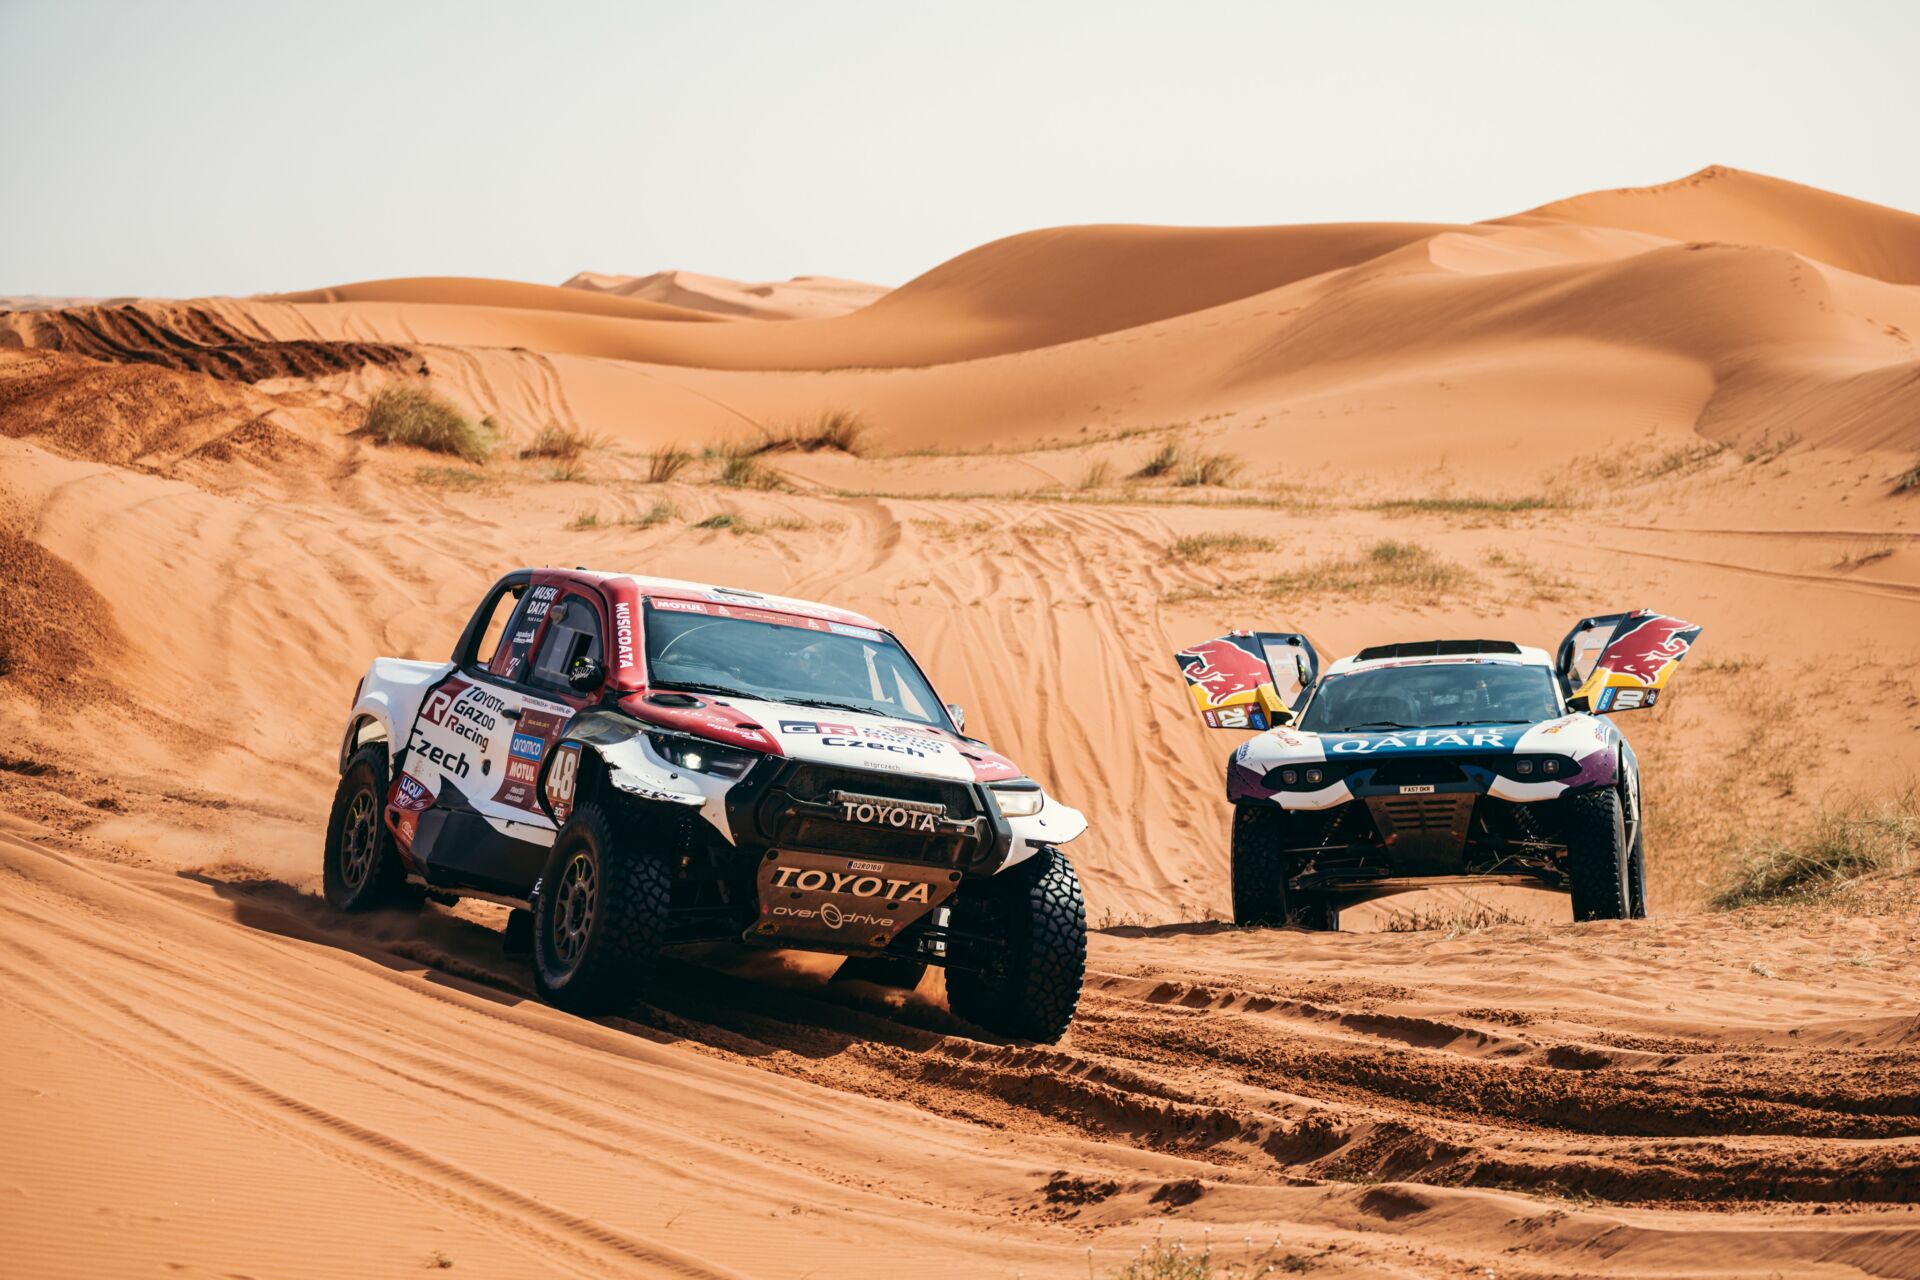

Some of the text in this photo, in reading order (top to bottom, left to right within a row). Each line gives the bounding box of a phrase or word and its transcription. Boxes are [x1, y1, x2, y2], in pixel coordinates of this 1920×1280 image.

[526, 601, 550, 616] DATA
[657, 601, 703, 612] MOTUL
[615, 602, 634, 669] MUSICDATA
[466, 686, 505, 714] TOYOTA
[453, 700, 496, 731] GAZOO
[444, 715, 490, 754] Racing
[783, 725, 857, 737] GR
[512, 738, 541, 757] aramco
[822, 737, 925, 758] Czech
[1332, 734, 1505, 754] QATAR
[509, 761, 535, 782] MOTUL
[549, 749, 578, 800] 48
[844, 802, 936, 832] TOYOTA
[775, 866, 929, 904] TOYOTA
